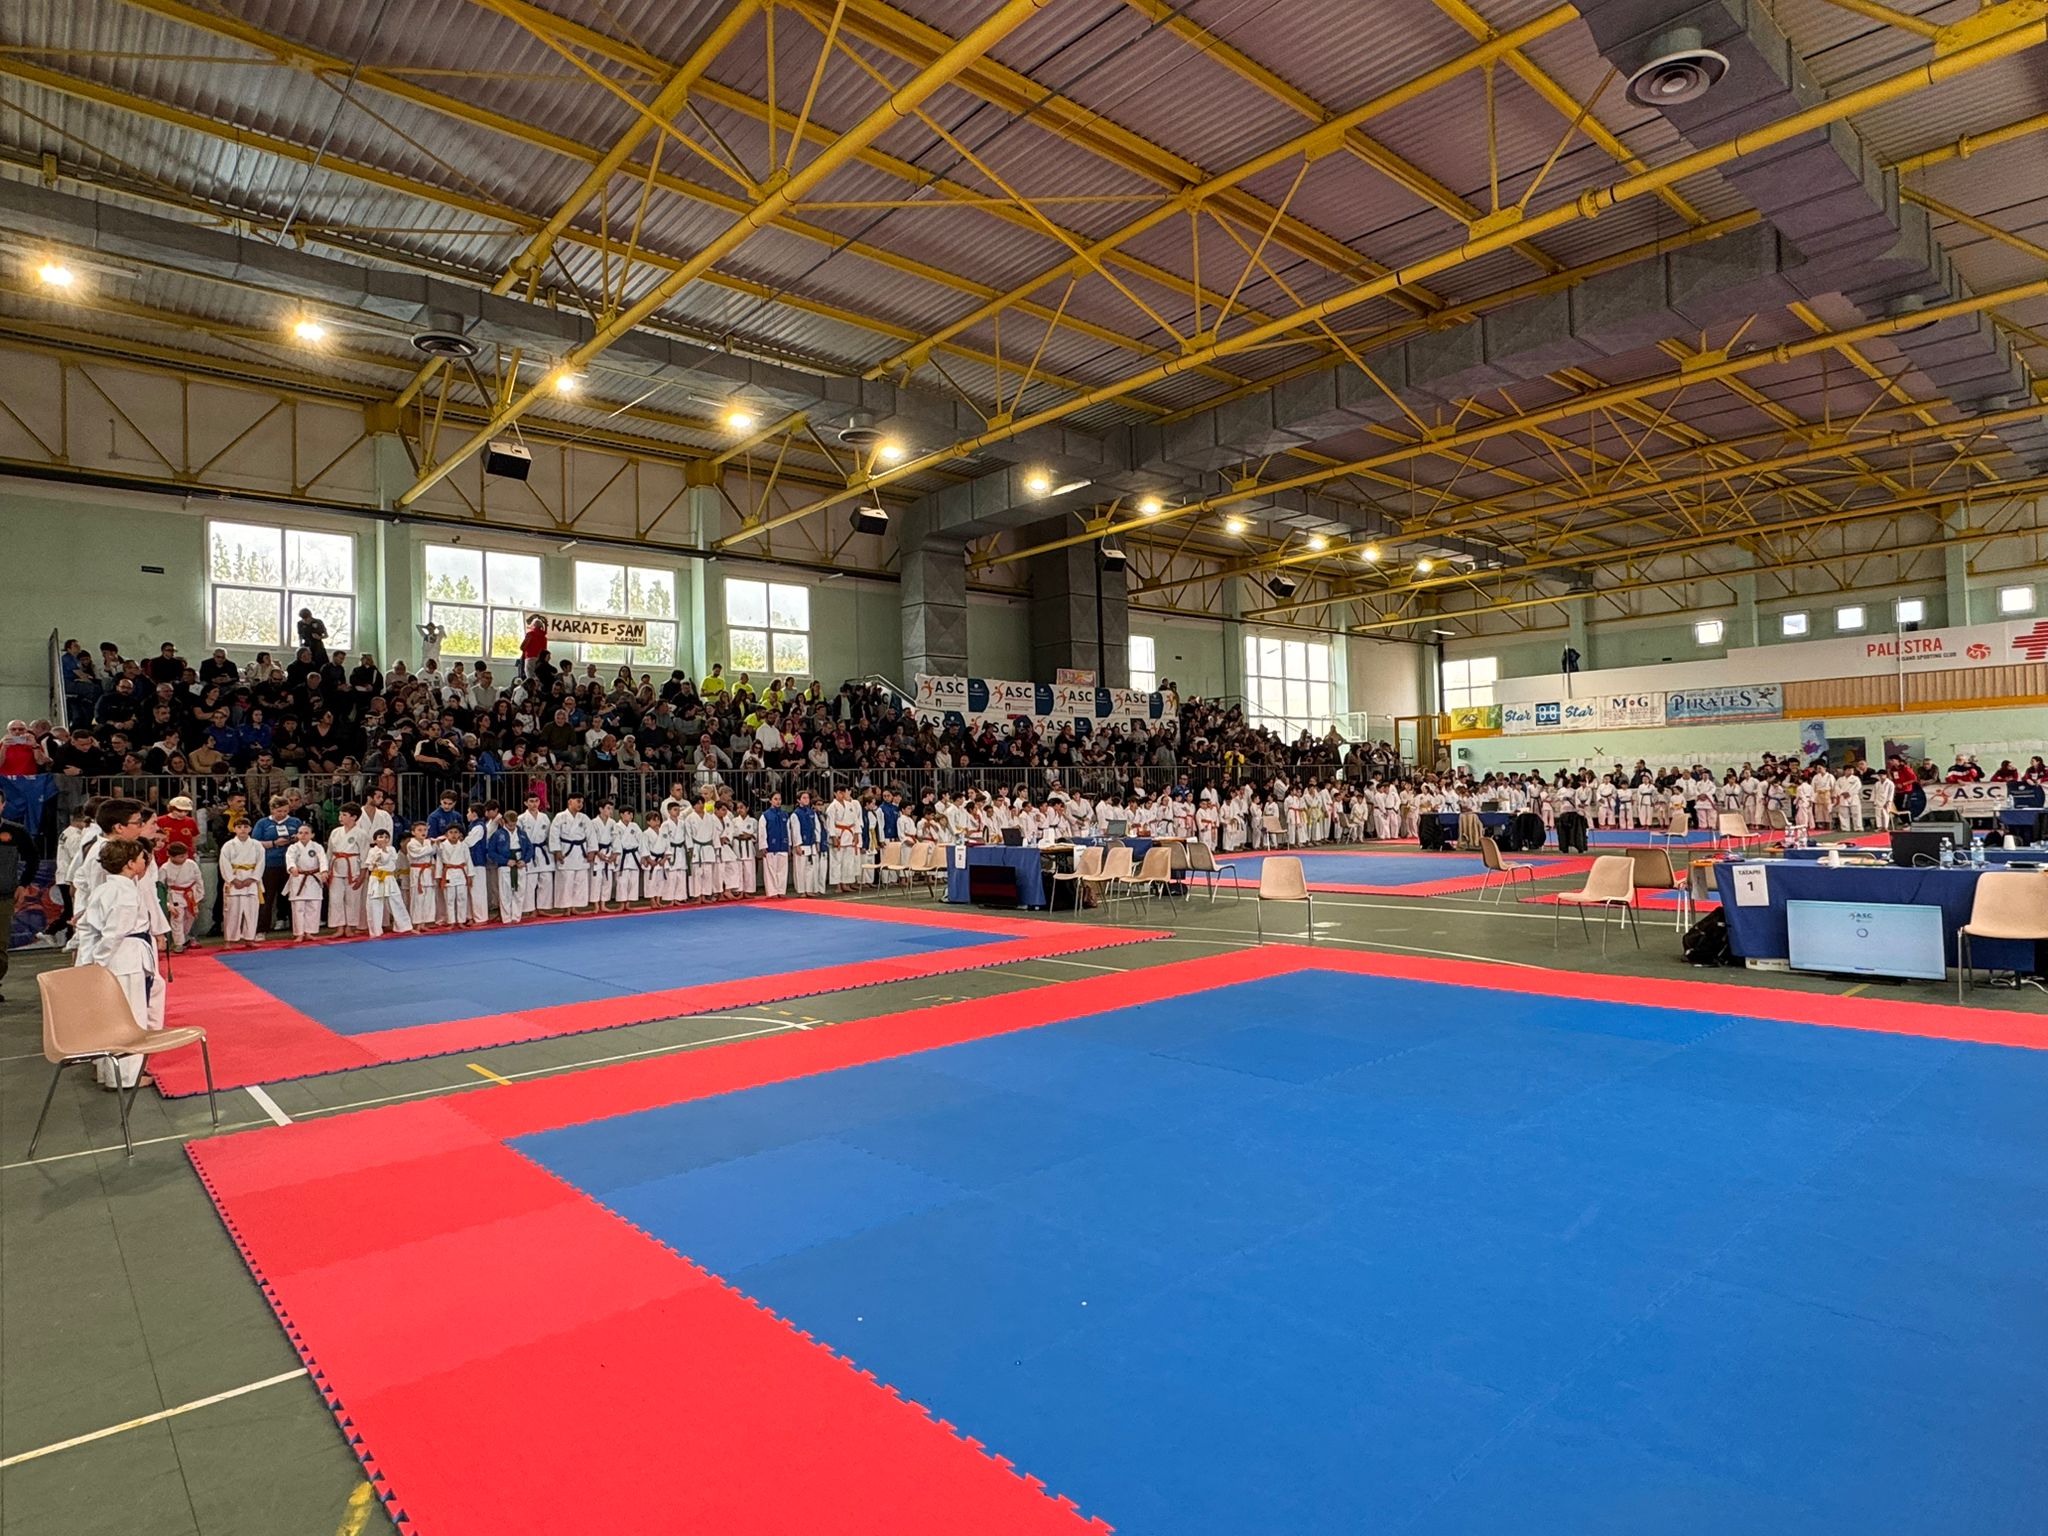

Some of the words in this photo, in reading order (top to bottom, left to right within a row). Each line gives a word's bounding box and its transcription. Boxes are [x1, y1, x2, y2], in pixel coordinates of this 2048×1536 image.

[551, 618, 644, 638] KARATE-SAN
[935, 681, 964, 694] ASC
[1005, 686, 1032, 699] ASC
[1068, 690, 1093, 702] ASC
[1124, 693, 1147, 704] ASC
[1669, 690, 1752, 711] PIRATES
[1504, 709, 1532, 723] Star
[1565, 705, 1594, 719] Star
[1953, 786, 2001, 800] ASC
[1747, 881, 1754, 892] 1
